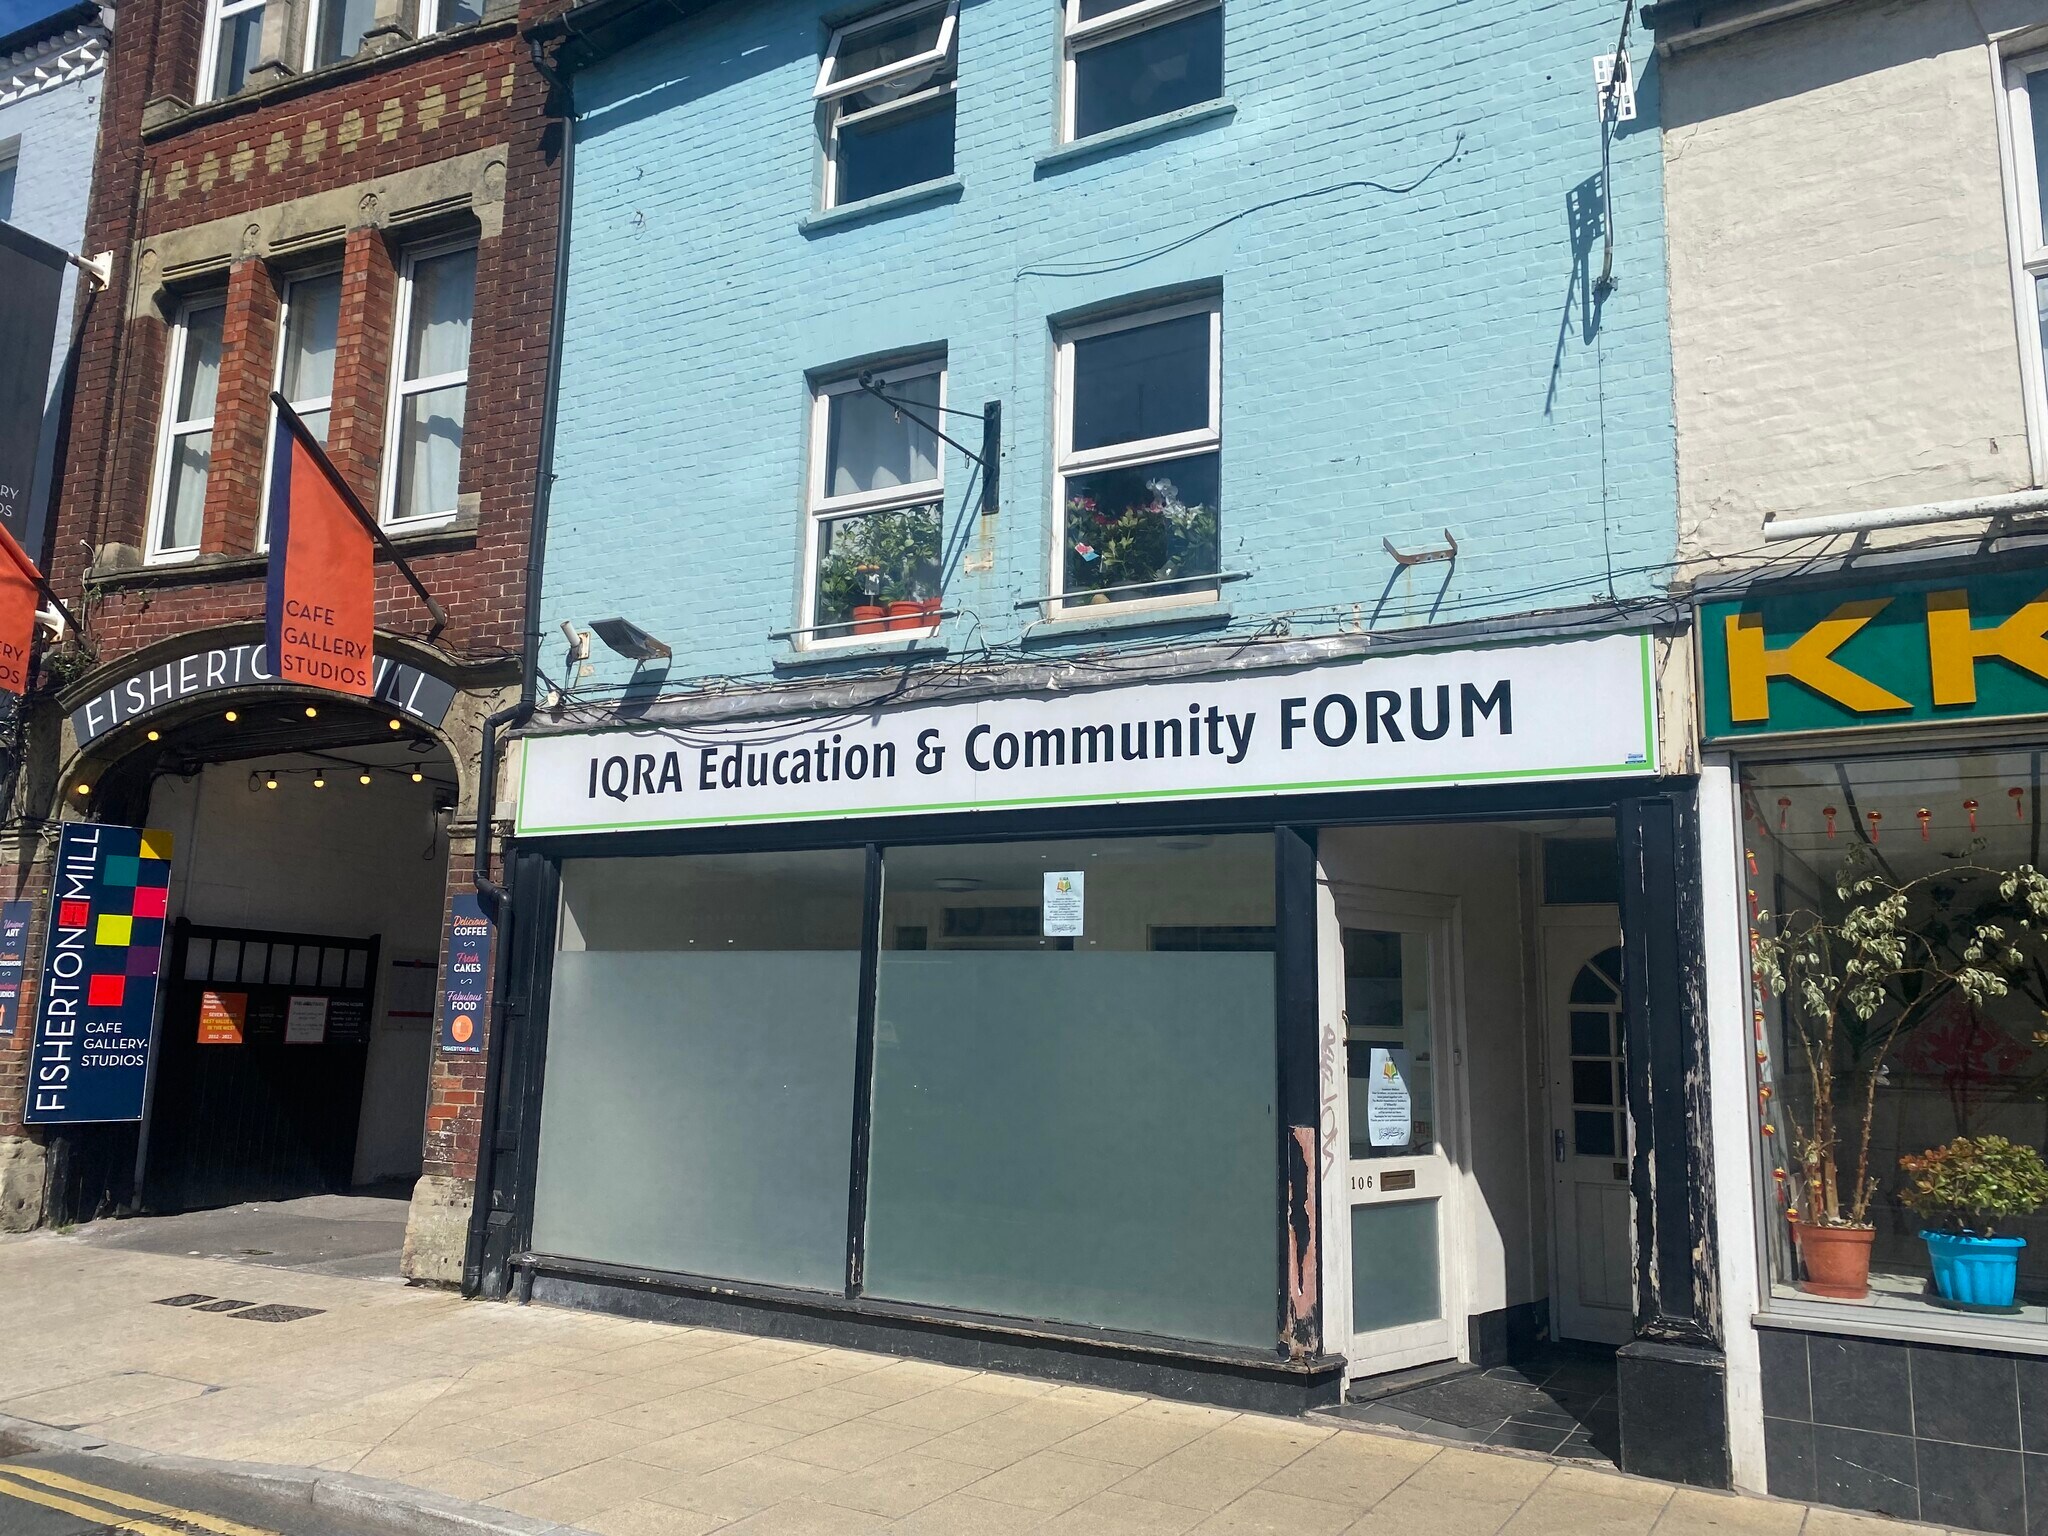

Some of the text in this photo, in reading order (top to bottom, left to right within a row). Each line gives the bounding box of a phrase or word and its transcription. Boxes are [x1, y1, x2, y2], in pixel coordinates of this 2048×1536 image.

[286, 600, 334, 626] CAFE
[284, 627, 367, 660] GALLERY
[283, 655, 367, 686] STUDIOS
[588, 680, 1513, 802] IQRA Education & Community FORUM
[453, 915, 488, 927] Delicious
[5, 929, 20, 937] ART
[454, 927, 487, 936] COFFEE
[456, 952, 479, 963] Fresh
[35, 829, 99, 1110] FISHERTON MILL
[453, 963, 481, 972] CAKES
[447, 990, 483, 1001] Fabulous
[452, 1001, 477, 1010] FOOD
[85, 1022, 123, 1034] CAFE
[83, 1038, 146, 1050] GALLERY
[81, 1054, 144, 1067] STUDIOS
[1351, 1176, 1373, 1190] 106
